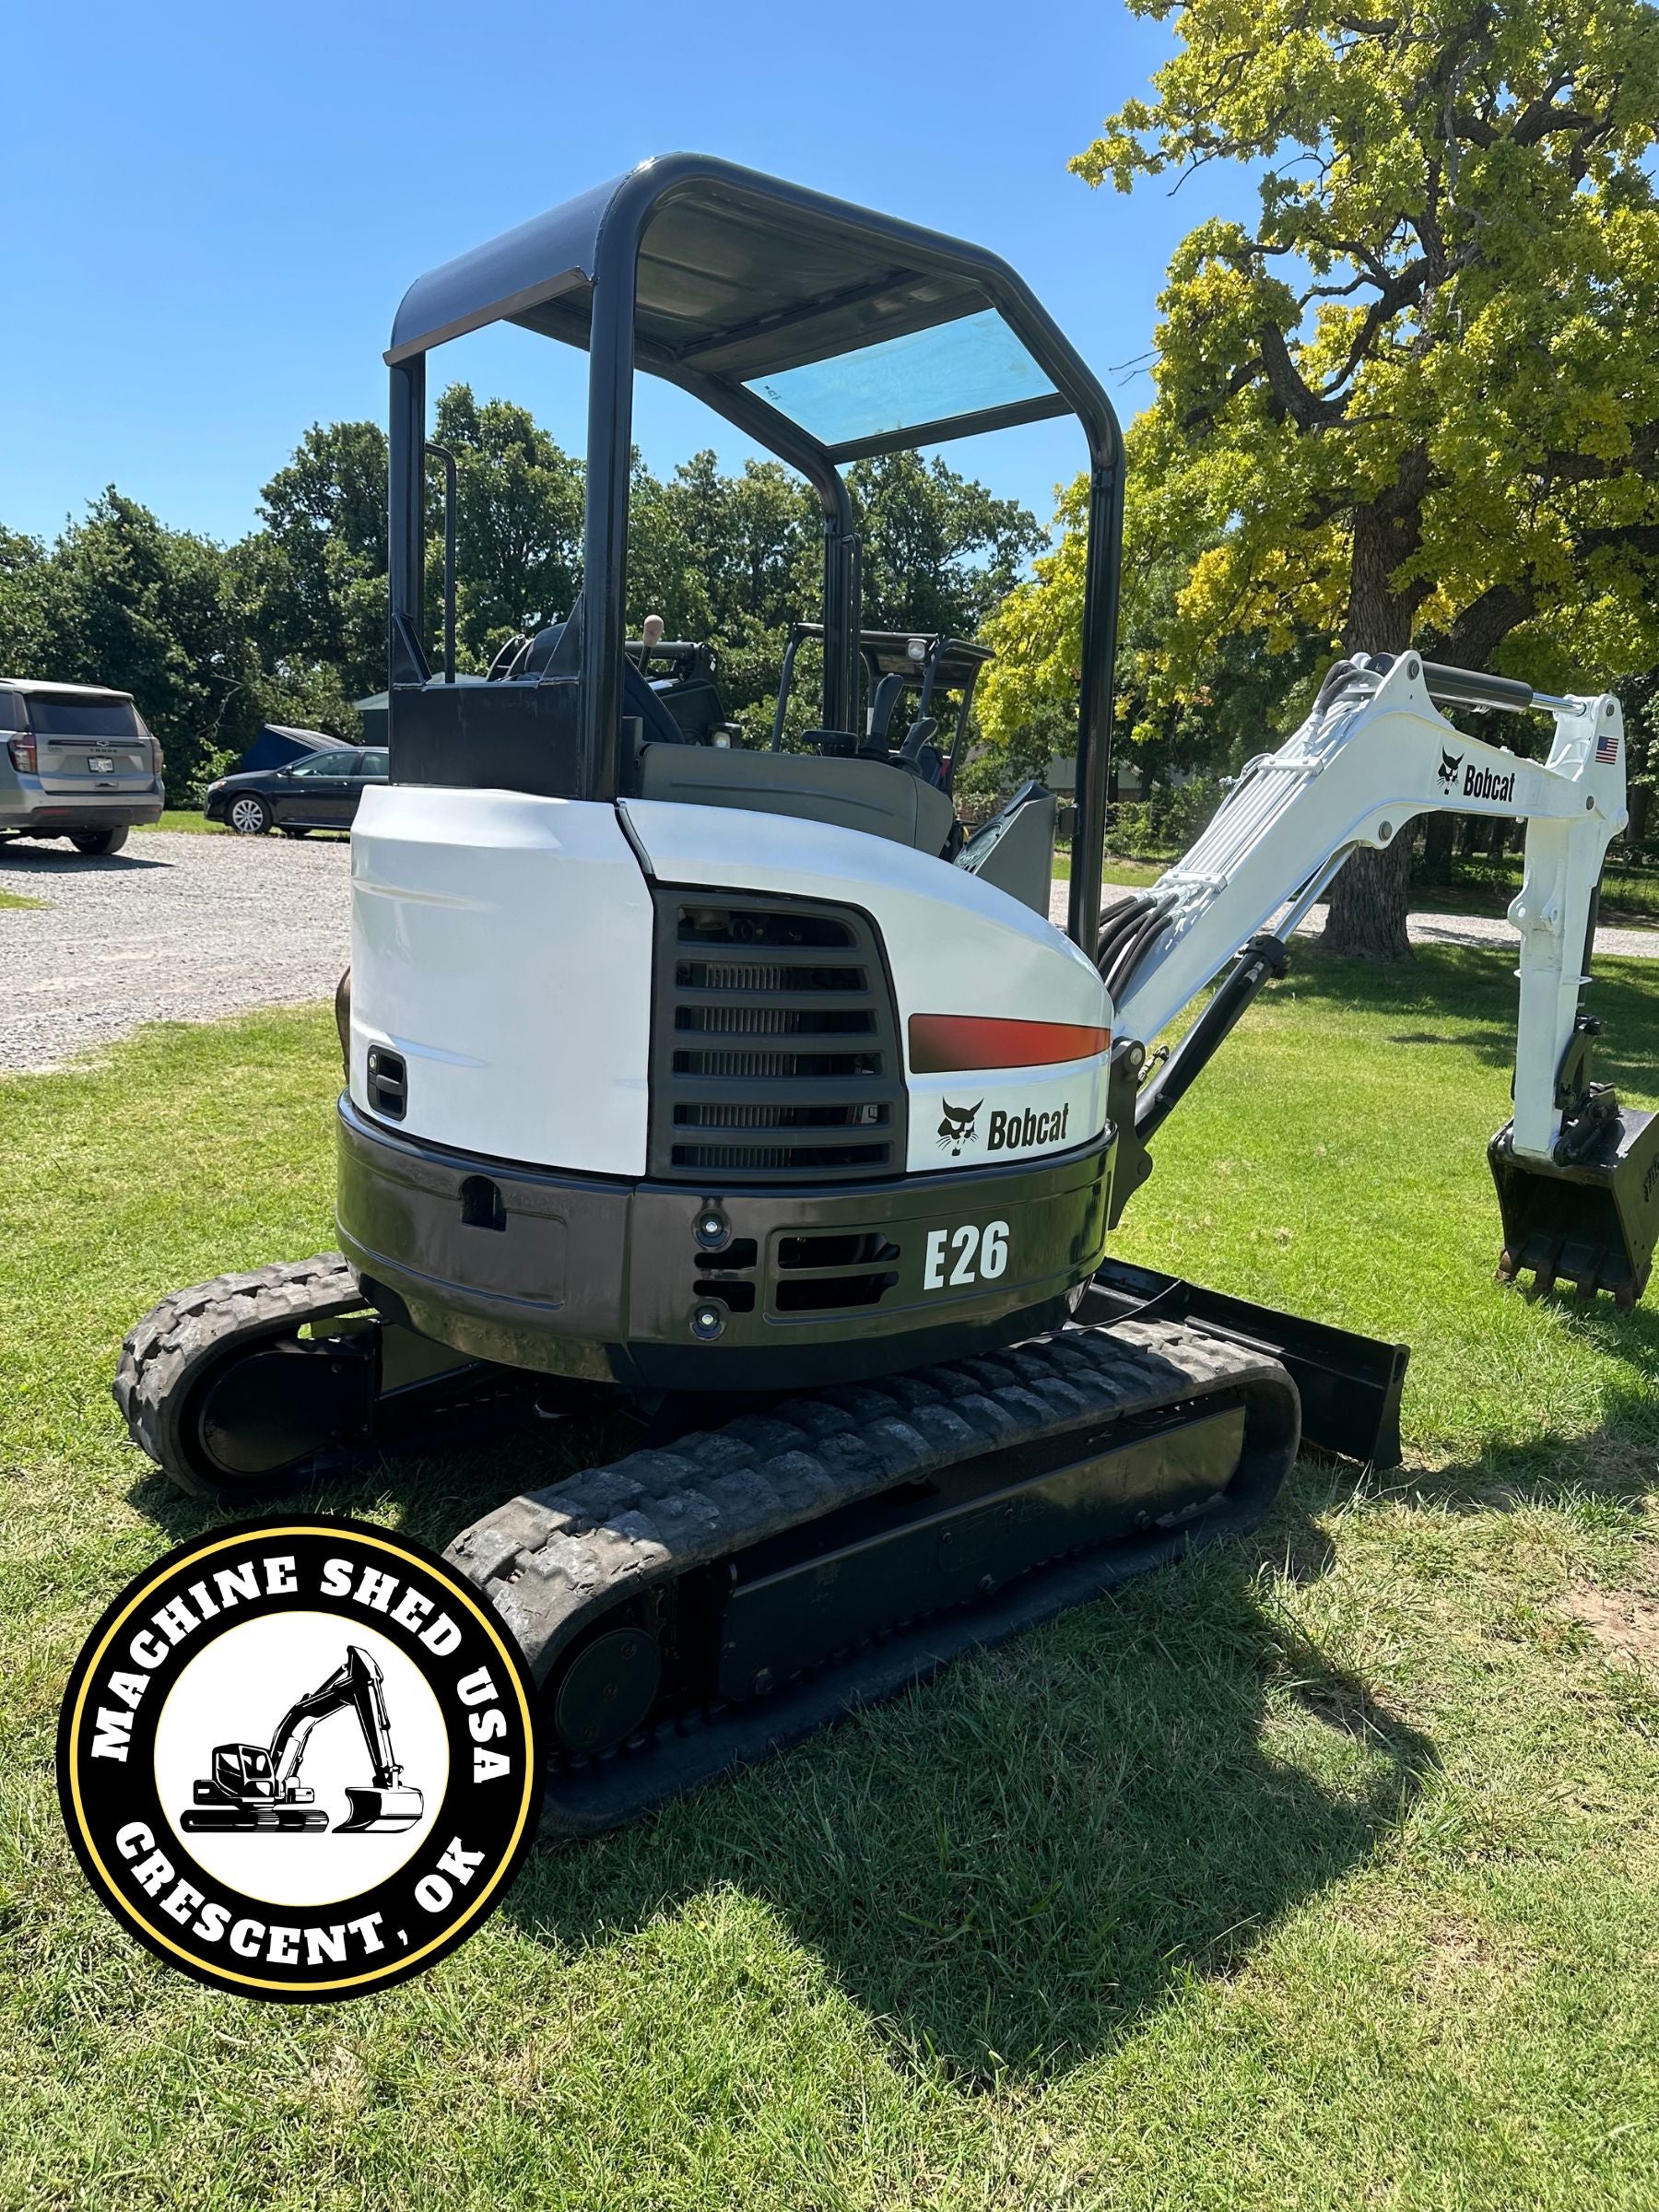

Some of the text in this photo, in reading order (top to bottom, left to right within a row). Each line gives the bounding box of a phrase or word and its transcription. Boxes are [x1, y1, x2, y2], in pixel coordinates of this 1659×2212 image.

[1463, 764, 1515, 803] Bobcat
[986, 1102, 1069, 1151] Bobcat
[924, 1220, 1010, 1290] E26
